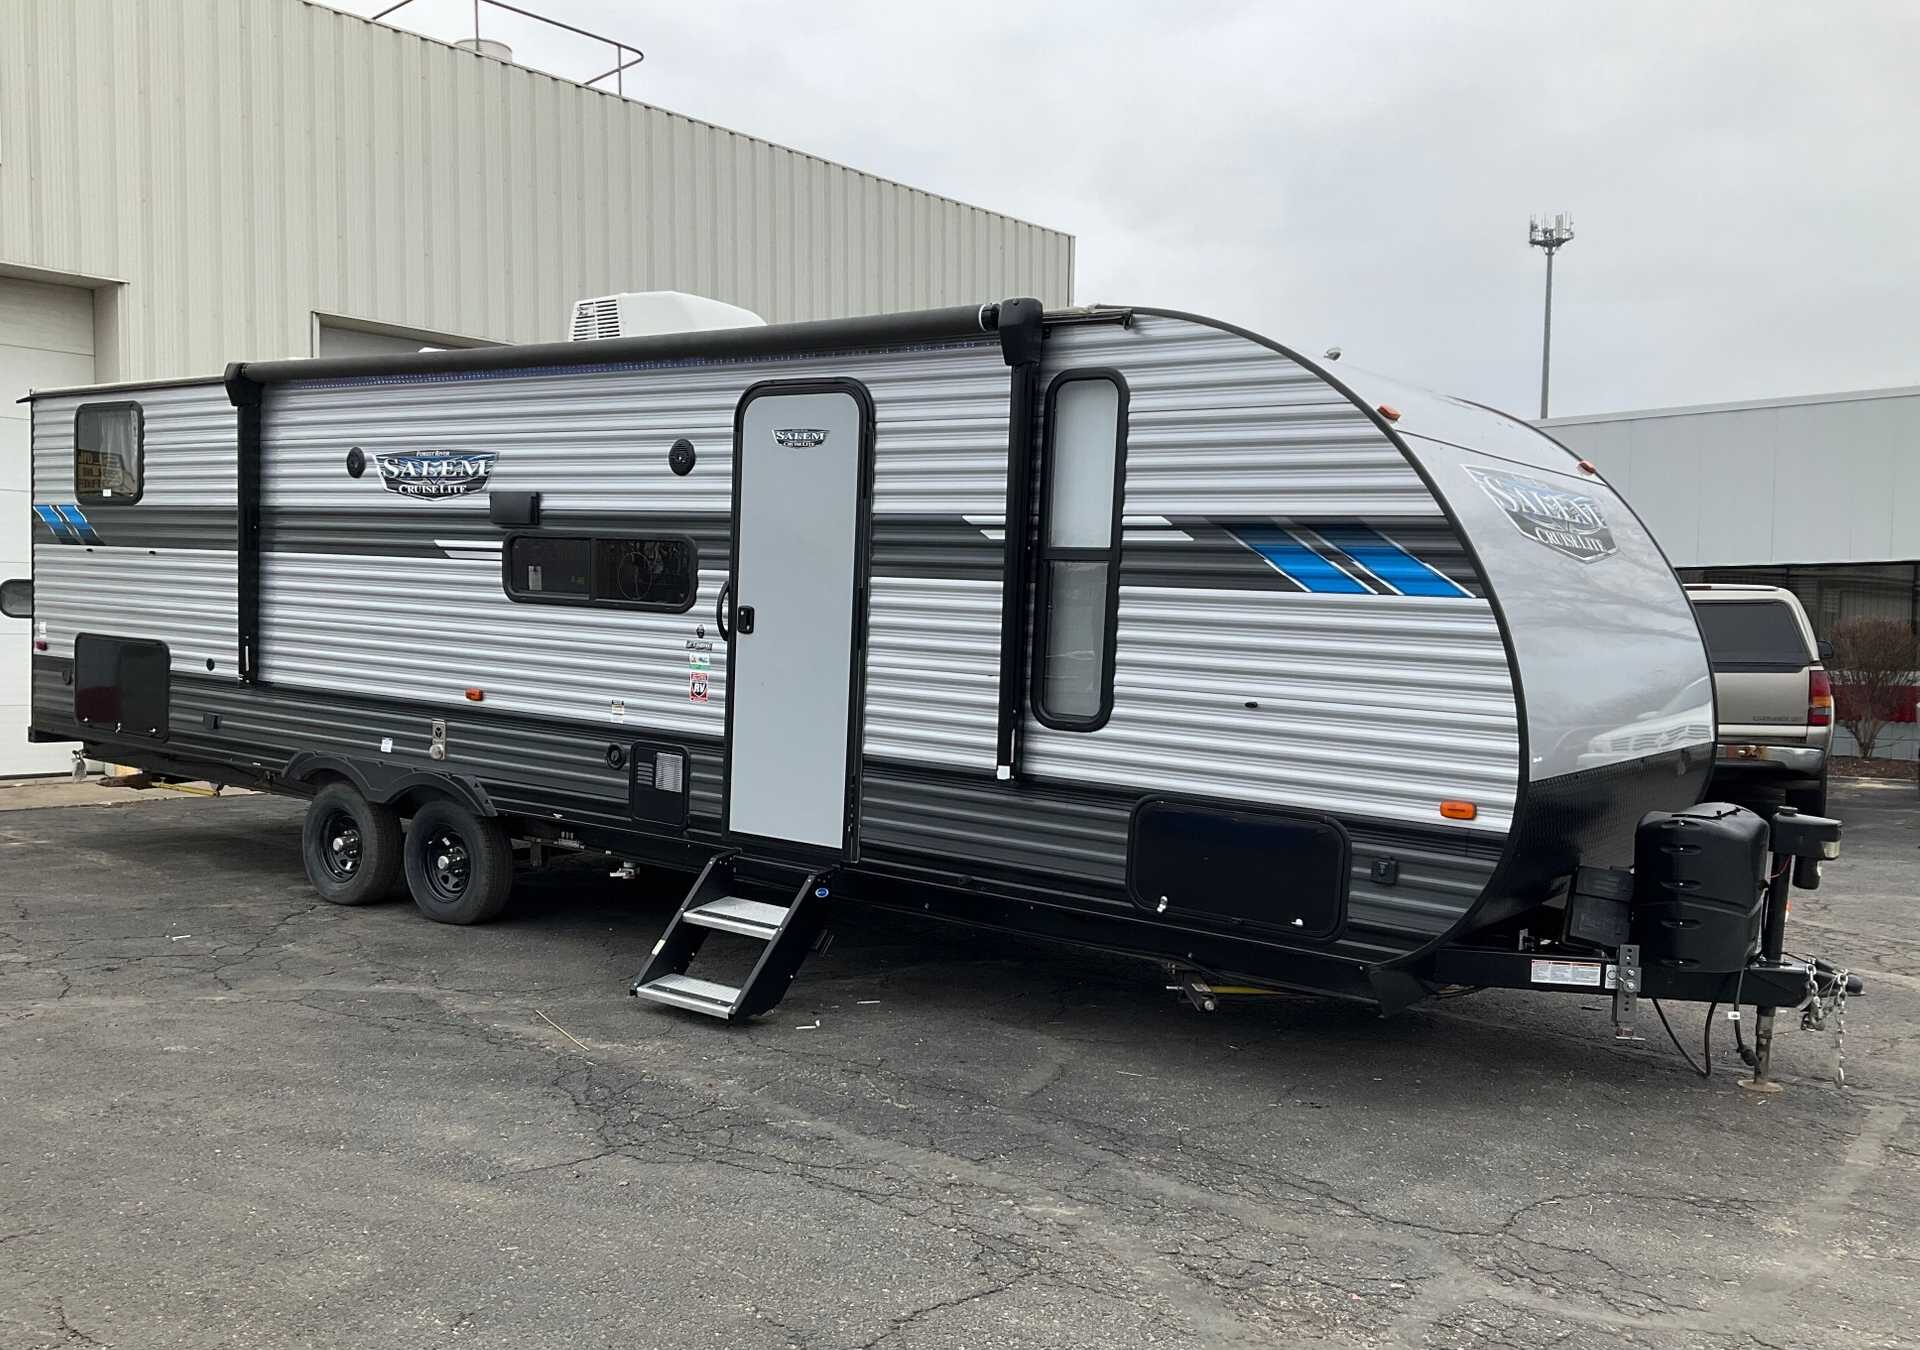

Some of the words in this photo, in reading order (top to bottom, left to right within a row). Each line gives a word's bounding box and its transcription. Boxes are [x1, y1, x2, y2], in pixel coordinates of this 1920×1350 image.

[383, 458, 489, 478] SALEM
[1484, 476, 1608, 528] SALEM
[693, 683, 705, 693] RV
